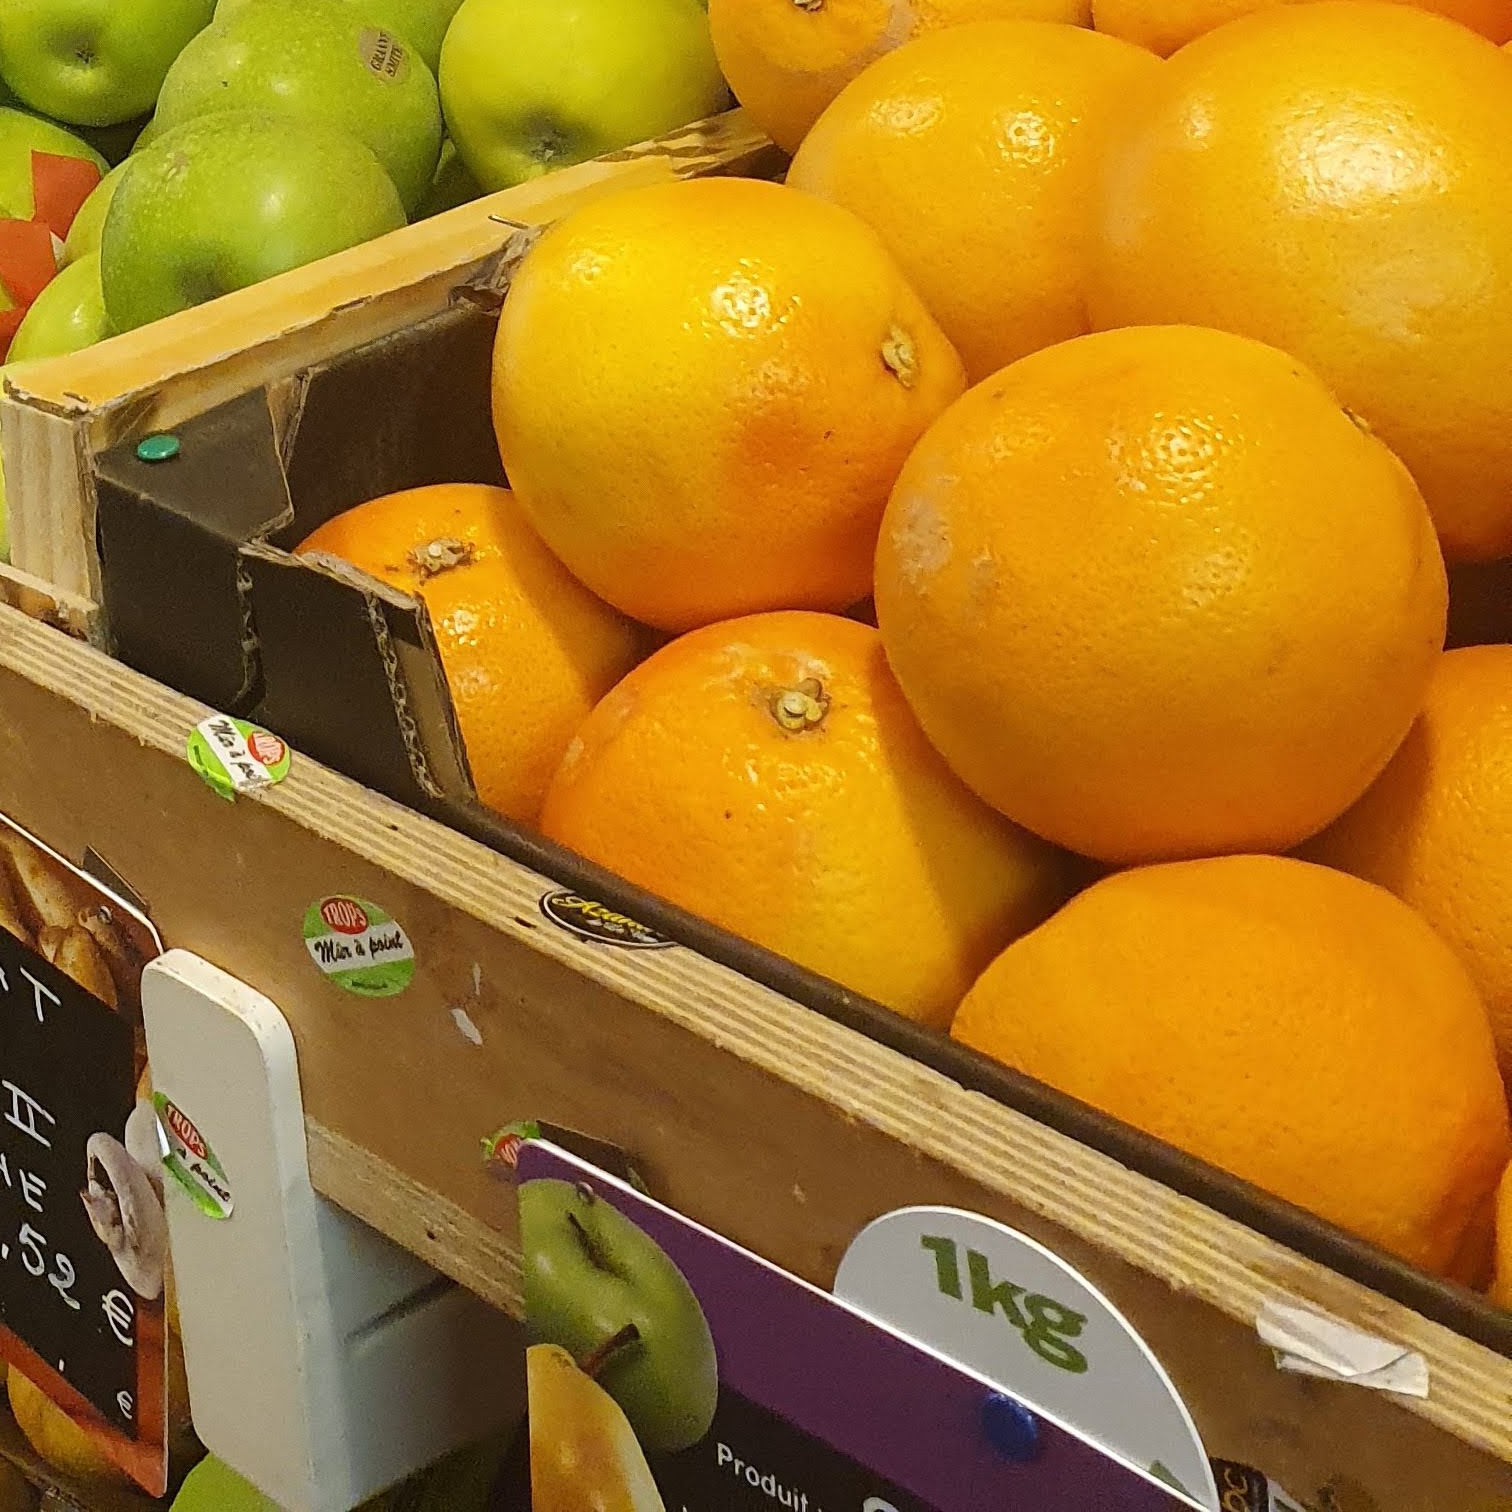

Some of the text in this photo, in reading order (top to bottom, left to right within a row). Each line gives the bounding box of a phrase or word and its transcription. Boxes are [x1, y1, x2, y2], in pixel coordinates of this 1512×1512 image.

[323, 901, 367, 928] TROPS
[101, 1289, 134, 1347] €
[921, 1235, 1088, 1374] 1kg
[717, 1442, 809, 1512] Produit
